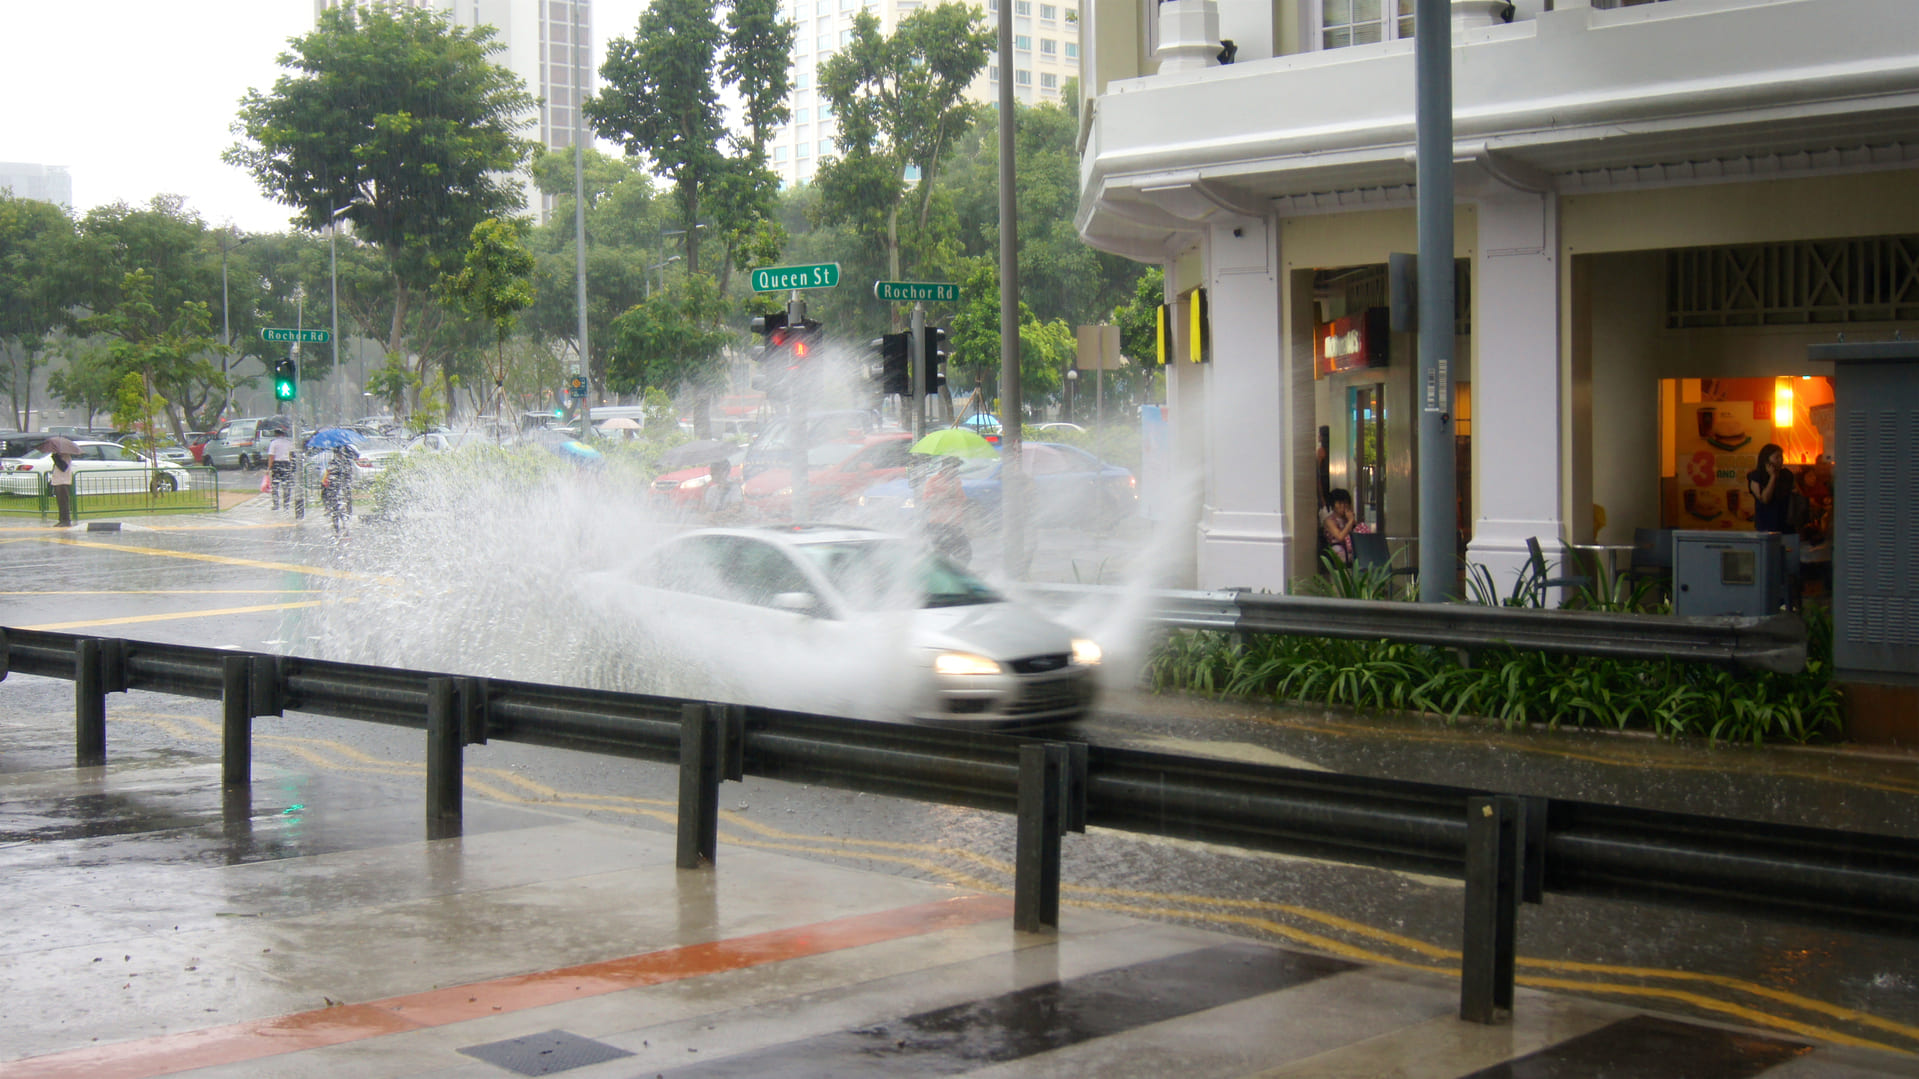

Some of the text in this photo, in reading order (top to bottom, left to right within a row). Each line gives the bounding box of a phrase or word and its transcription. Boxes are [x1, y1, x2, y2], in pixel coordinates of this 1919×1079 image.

[760, 267, 830, 288] Queen St
[884, 284, 953, 300] Rochor Rd
[268, 330, 324, 341] Rochor Rd
